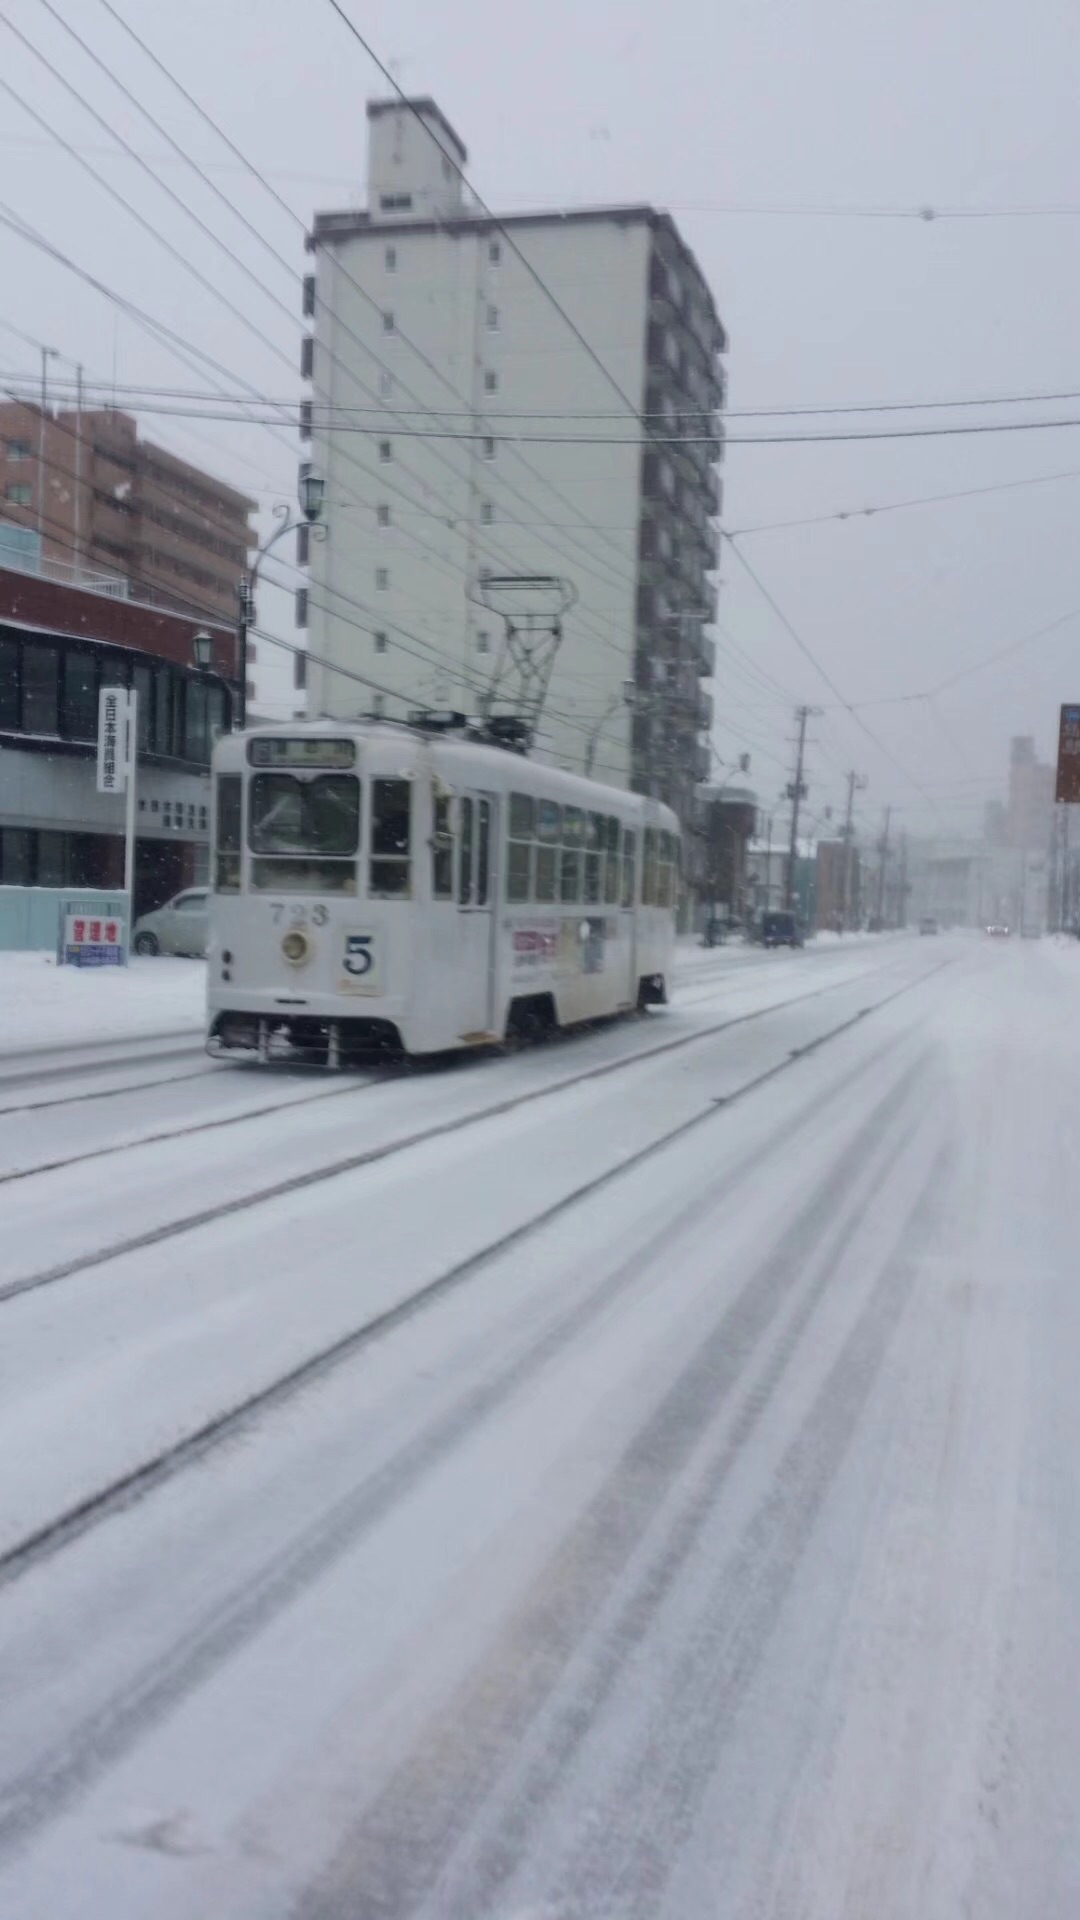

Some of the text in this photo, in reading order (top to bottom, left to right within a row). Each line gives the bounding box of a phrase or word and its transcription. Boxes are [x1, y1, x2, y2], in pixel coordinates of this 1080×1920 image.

[269, 902, 330, 927] 723
[73, 918, 117, 943] 管理地
[342, 935, 373, 976] 5
